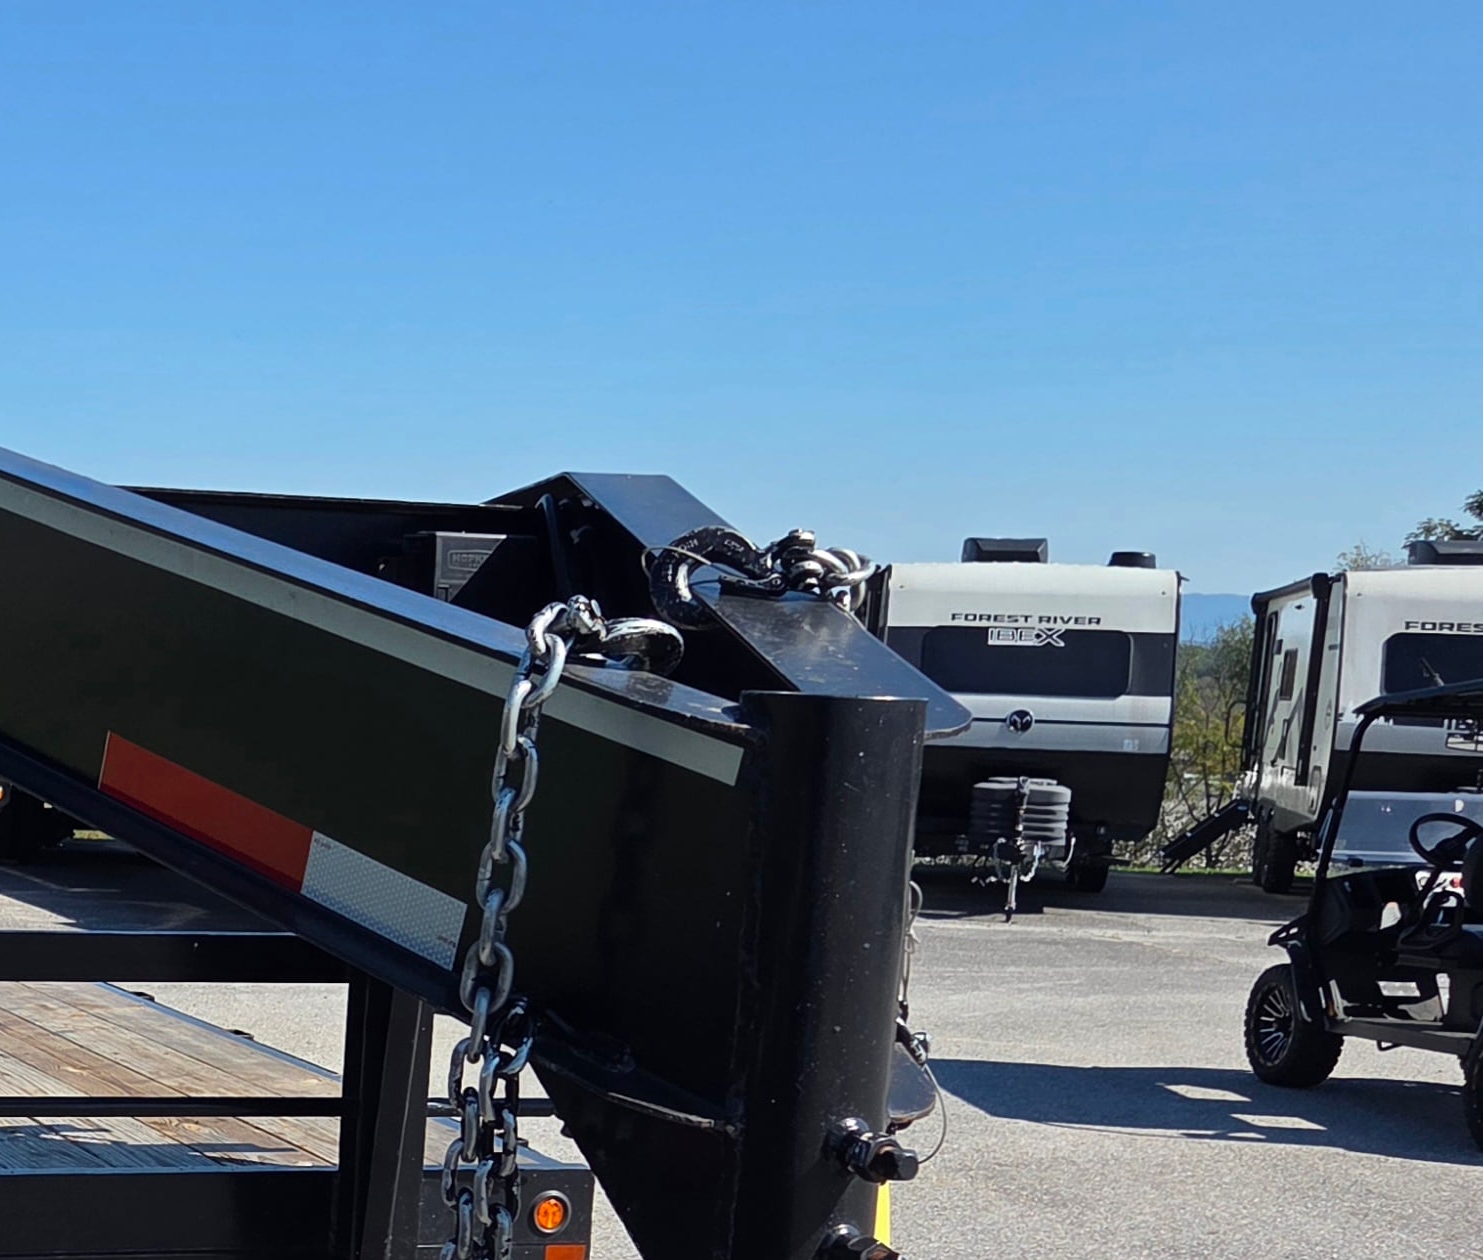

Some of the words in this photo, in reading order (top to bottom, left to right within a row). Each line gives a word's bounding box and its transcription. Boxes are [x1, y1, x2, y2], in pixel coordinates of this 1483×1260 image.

[951, 613, 1033, 623] FOREST
[1038, 615, 1101, 625] RIVER
[988, 627, 1066, 647] IBEX
